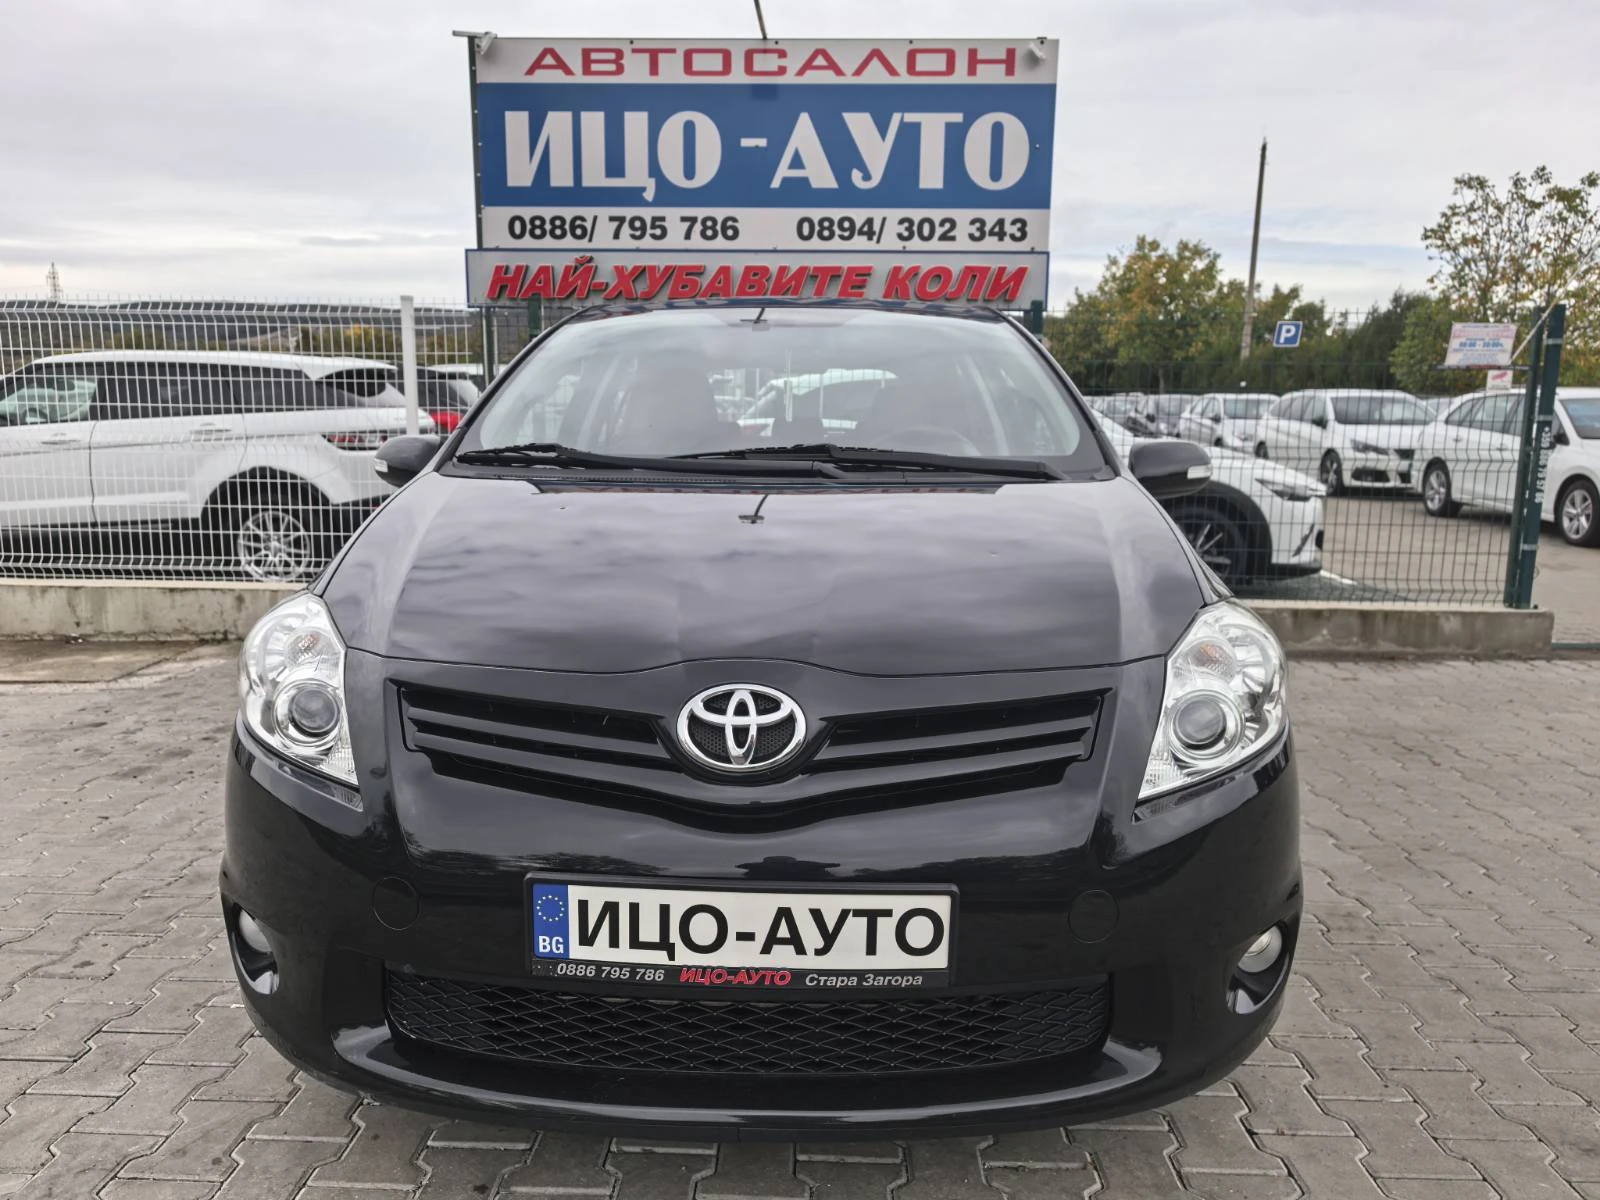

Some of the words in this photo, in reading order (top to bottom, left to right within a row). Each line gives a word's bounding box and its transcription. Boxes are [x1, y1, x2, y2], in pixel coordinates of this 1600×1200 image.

[524, 47, 1016, 77] АВТОСАЛОН
[504, 110, 722, 202] ИЦО
[507, 215, 598, 243] 0886/
[608, 216, 668, 240] 795
[680, 216, 740, 241] 786
[796, 216, 886, 243] 0894/
[896, 217, 957, 242] 302
[968, 217, 1028, 242] 343
[486, 256, 873, 301] НАЙ-ХУБАВИТЕ
[882, 264, 1029, 301] КОЛИ
[1280, 325, 1296, 343] P
[577, 898, 945, 961] ИЦО-АУТО
[538, 935, 564, 954] BG
[557, 963, 596, 977] 0886
[600, 965, 631, 980] 795
[635, 967, 665, 982] 786
[680, 966, 791, 986] ИЦО-АУТО
[805, 972, 857, 989] Стара
[862, 972, 923, 988] Загора
